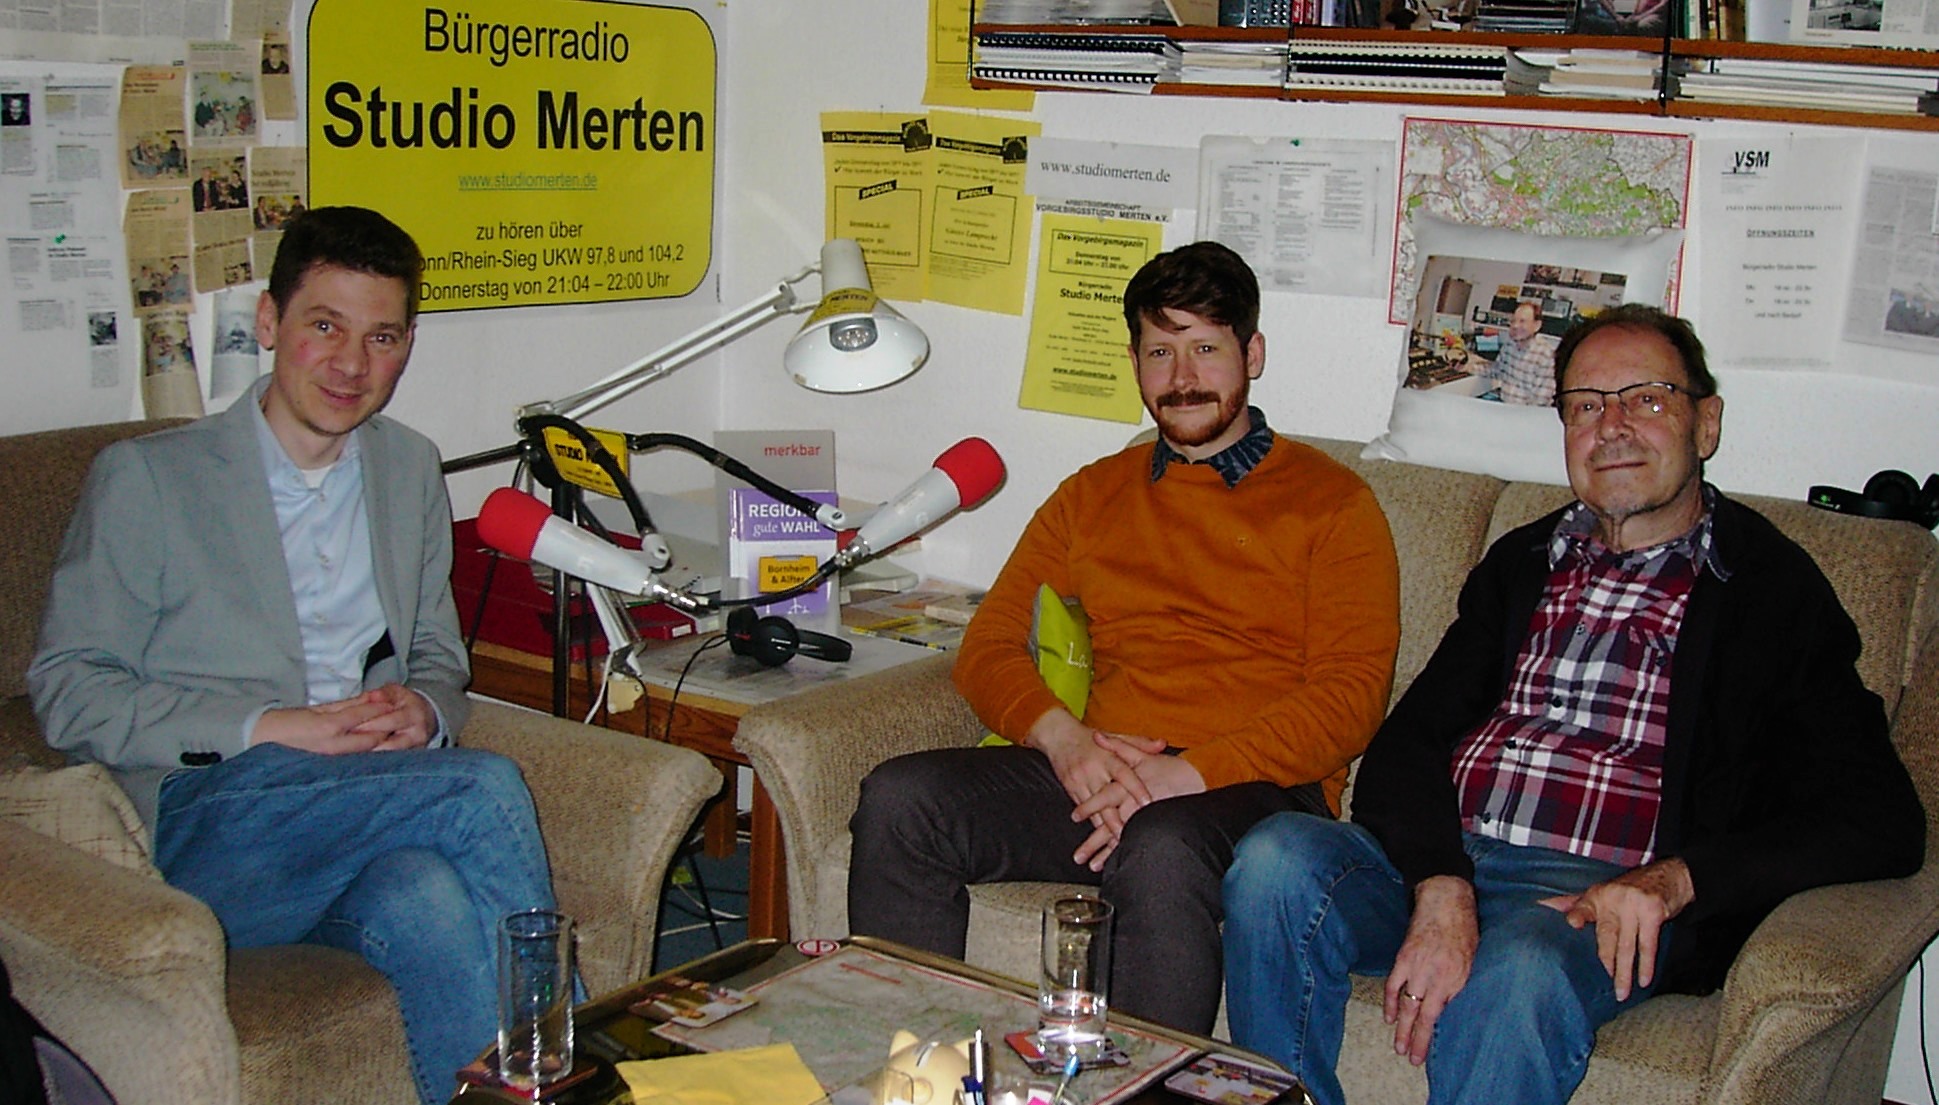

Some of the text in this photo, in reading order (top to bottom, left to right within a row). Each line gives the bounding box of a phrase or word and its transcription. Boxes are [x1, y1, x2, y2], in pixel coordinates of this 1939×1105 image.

[425, 8, 630, 67] Bürgerradio
[323, 81, 704, 151] Studio Merten
[1735, 151, 1770, 168] VSM
[1041, 160, 1171, 183] www.studiomerten.de
[458, 173, 598, 190] www.studiomerten.de
[862, 183, 893, 198] SPECIAL
[1036, 204, 1115, 217] VORGEBIRGSSTUDIO
[1119, 211, 1151, 220] MERTEN
[476, 221, 583, 240] zu hören über
[1057, 232, 1144, 248] Das Vorgebirgsmagazin
[420, 243, 684, 271] onn/Rhein-Sieg UKW 97,8 und 104,2
[420, 281, 508, 301] Donnerstag
[513, 281, 542, 295] von
[547, 275, 589, 294] 21:04
[607, 272, 642, 291] 22:00
[647, 271, 669, 288] Uhr
[1060, 288, 1125, 304] Studio Merte
[764, 444, 821, 457] merkbar
[753, 521, 820, 537] gute WAHL
[768, 564, 810, 574] Bornheim
[771, 575, 778, 584] &
